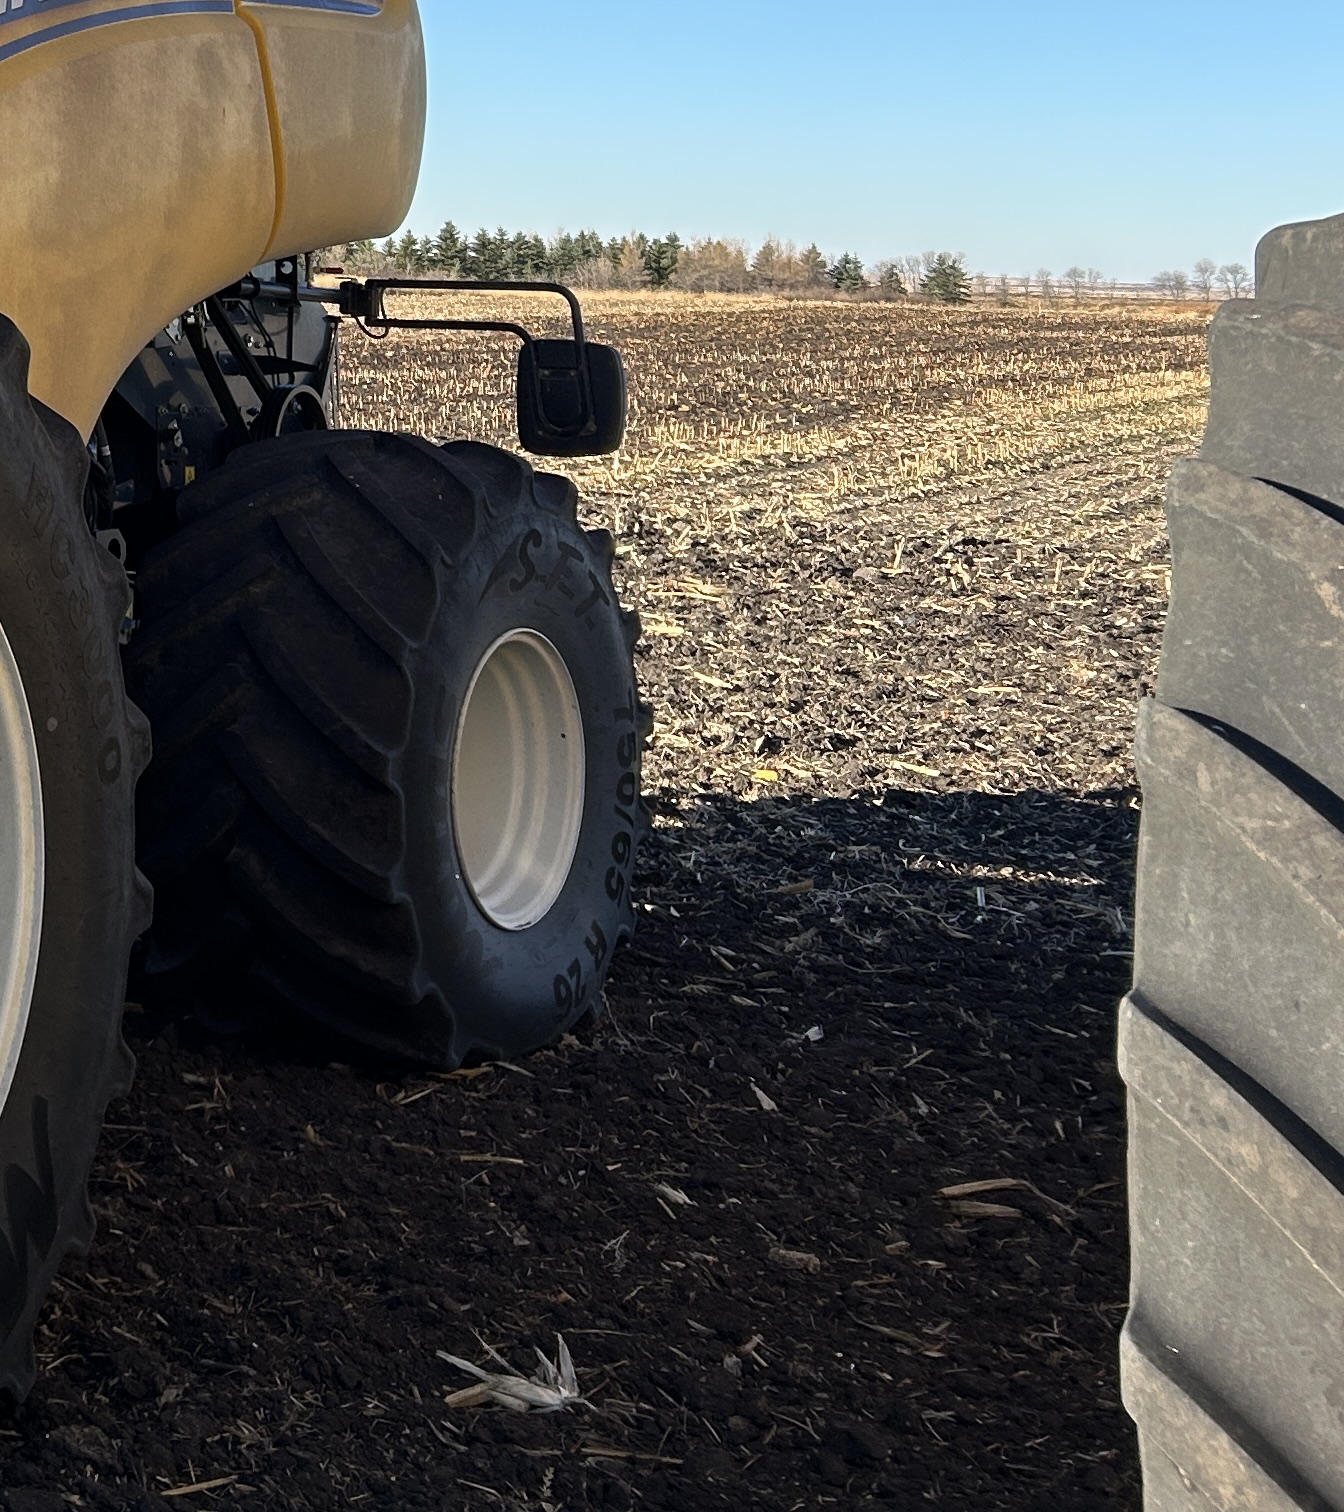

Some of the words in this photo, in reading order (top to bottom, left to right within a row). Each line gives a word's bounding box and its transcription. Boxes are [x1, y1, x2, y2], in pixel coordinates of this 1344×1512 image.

[604, 686, 637, 909] 750/65
[584, 919, 607, 973] R
[553, 957, 585, 1022] 26
